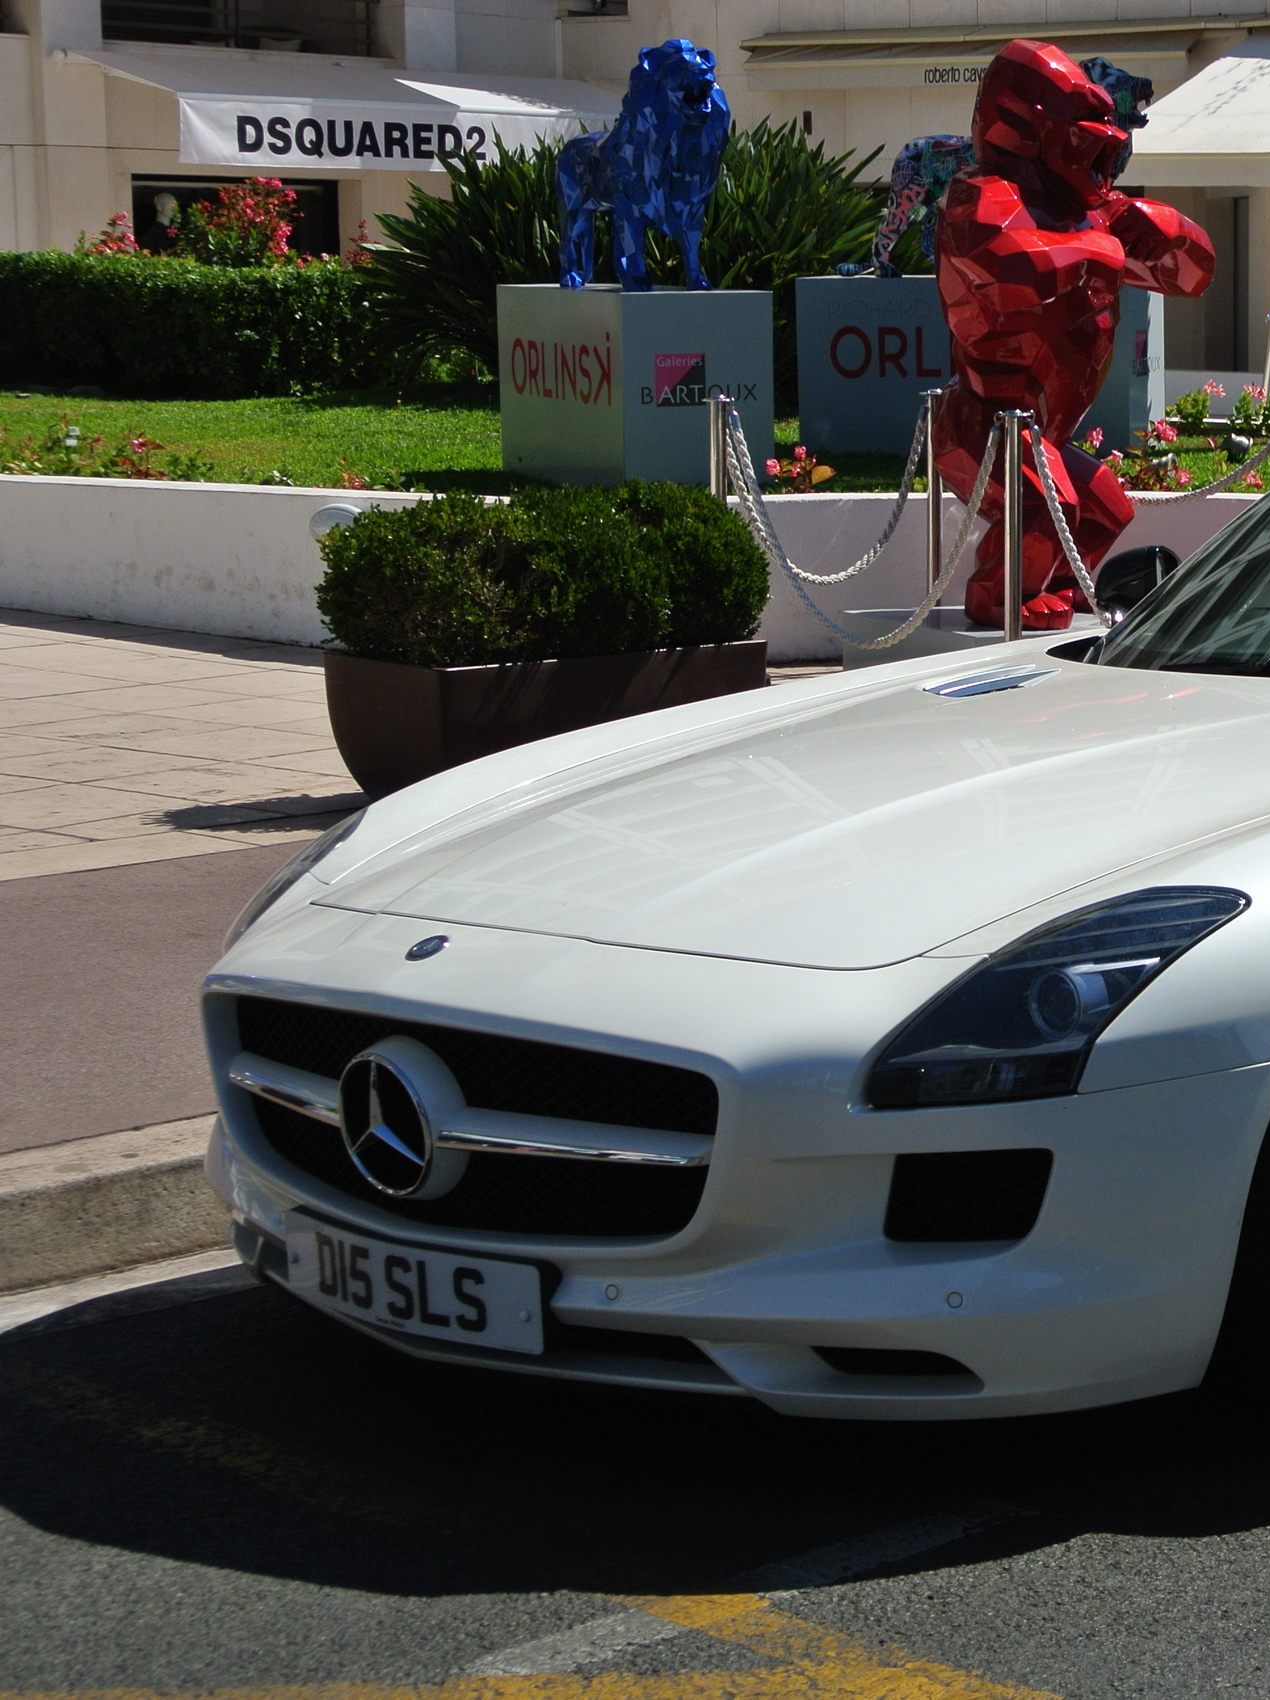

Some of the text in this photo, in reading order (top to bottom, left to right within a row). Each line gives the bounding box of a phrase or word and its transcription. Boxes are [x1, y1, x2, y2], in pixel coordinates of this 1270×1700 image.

[924, 66, 960, 84] roberto
[236, 115, 487, 160] DSQUARED2
[827, 299, 931, 320] RICHARD
[656, 355, 703, 368] Galeries
[641, 383, 757, 405] BARTOUX
[315, 1230, 488, 1333] D15 SLS
